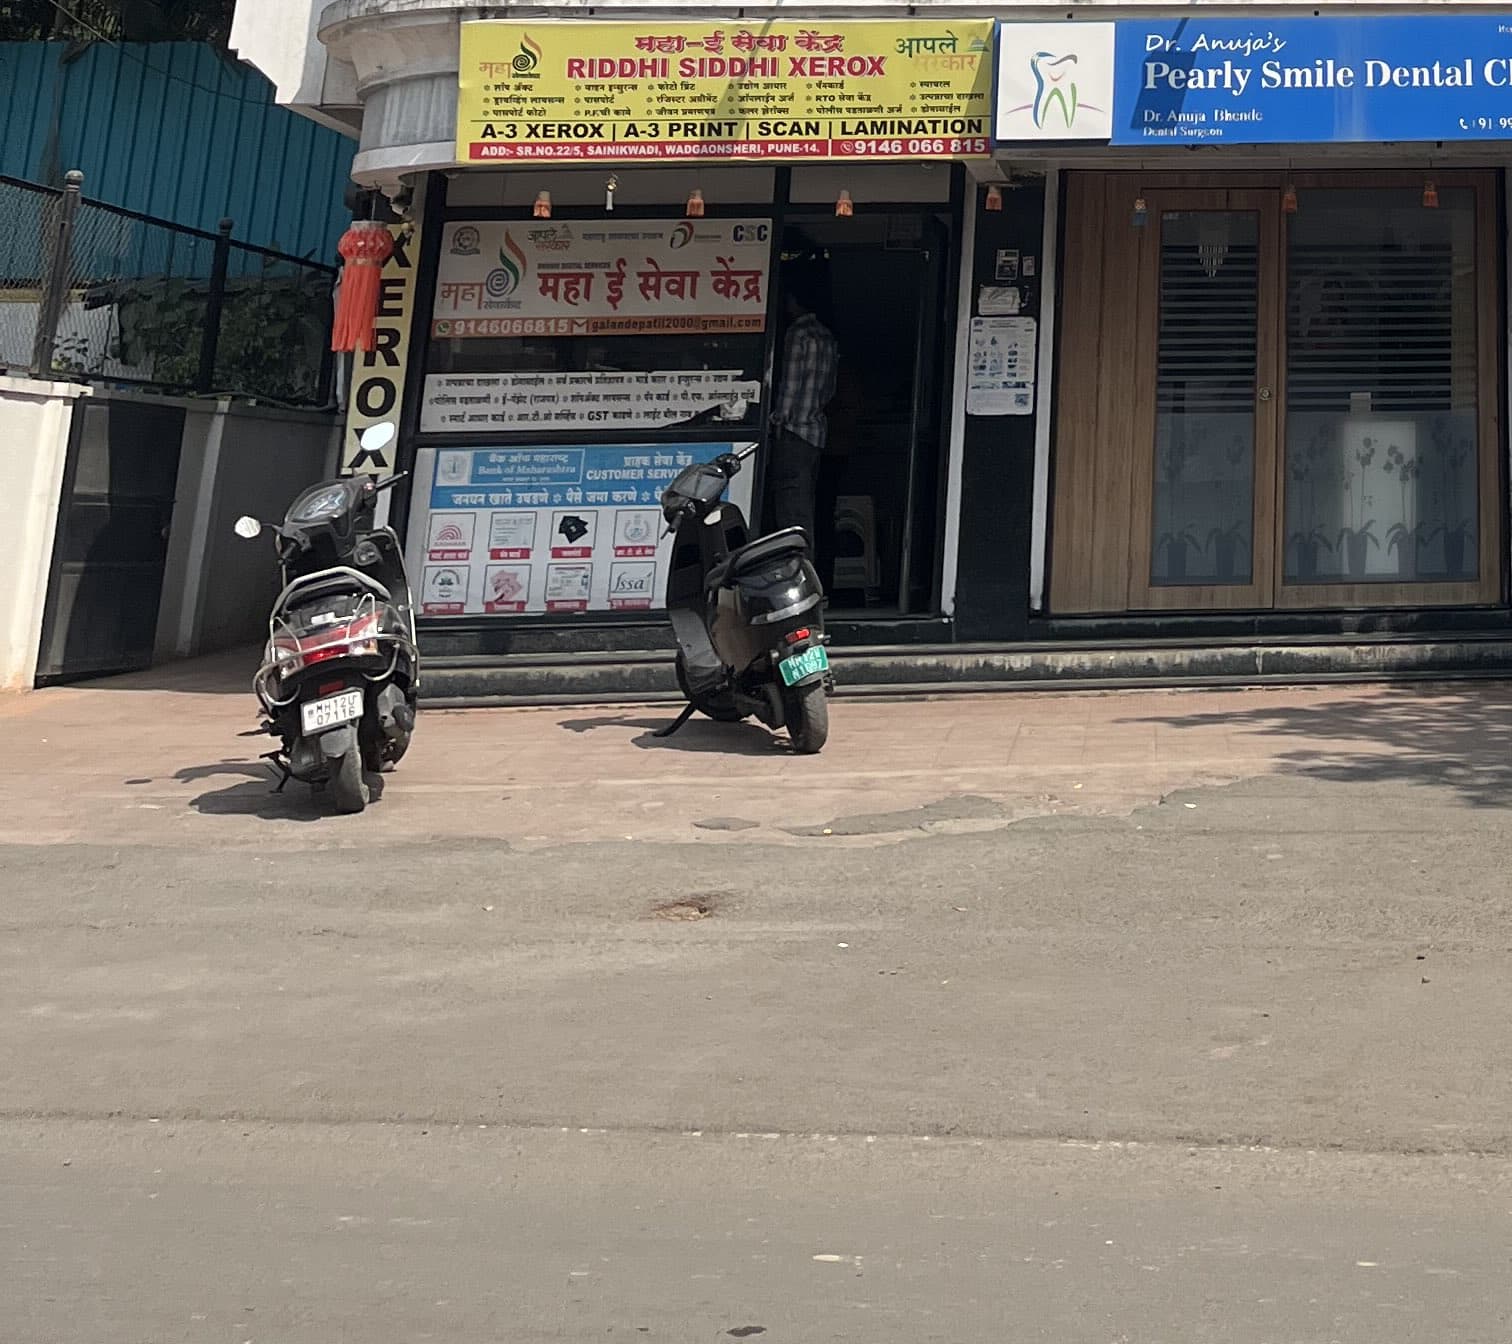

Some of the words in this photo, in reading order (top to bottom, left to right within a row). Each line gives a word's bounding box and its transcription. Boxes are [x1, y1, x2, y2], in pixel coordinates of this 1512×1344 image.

[730, 30, 790, 53] सेवा
[795, 30, 846, 53] केंद्र
[896, 30, 959, 58] आपले
[1145, 34, 1182, 52] Dr.
[1191, 31, 1287, 57] Anuja's
[479, 62, 512, 79] महा
[567, 57, 670, 79] RIDDHI
[679, 56, 779, 79] SIDDHI
[788, 55, 886, 78] XEROX
[1145, 60, 1252, 96] Pearly
[1261, 60, 1354, 89] Smile
[1365, 58, 1473, 88] Dental
[1143, 110, 1163, 123] Dr.
[1167, 110, 1207, 123] Anuja
[481, 123, 518, 139] A-3
[525, 123, 605, 138] XEROX
[624, 122, 660, 138] A-3
[668, 121, 738, 138] PRINT
[758, 121, 820, 137] SCAN
[841, 119, 983, 136] LAMINATION
[1143, 126, 1177, 137] Dental
[587, 144, 662, 157] SAINIKWADI,
[665, 143, 765, 157] WADGAONSHERI,
[855, 140, 903, 154] 9146
[908, 139, 945, 153] 066
[950, 139, 985, 152] 815
[732, 223, 768, 243] CSC
[537, 271, 594, 307] महा
[604, 256, 626, 310] ई
[636, 257, 701, 303] सेवा
[709, 255, 764, 305] केंद्र
[441, 281, 486, 311] महा
[454, 318, 569, 337] 9146066815
[587, 410, 609, 421] GST
[477, 465, 503, 475] Bank
[585, 469, 644, 481] CUSTOMER
